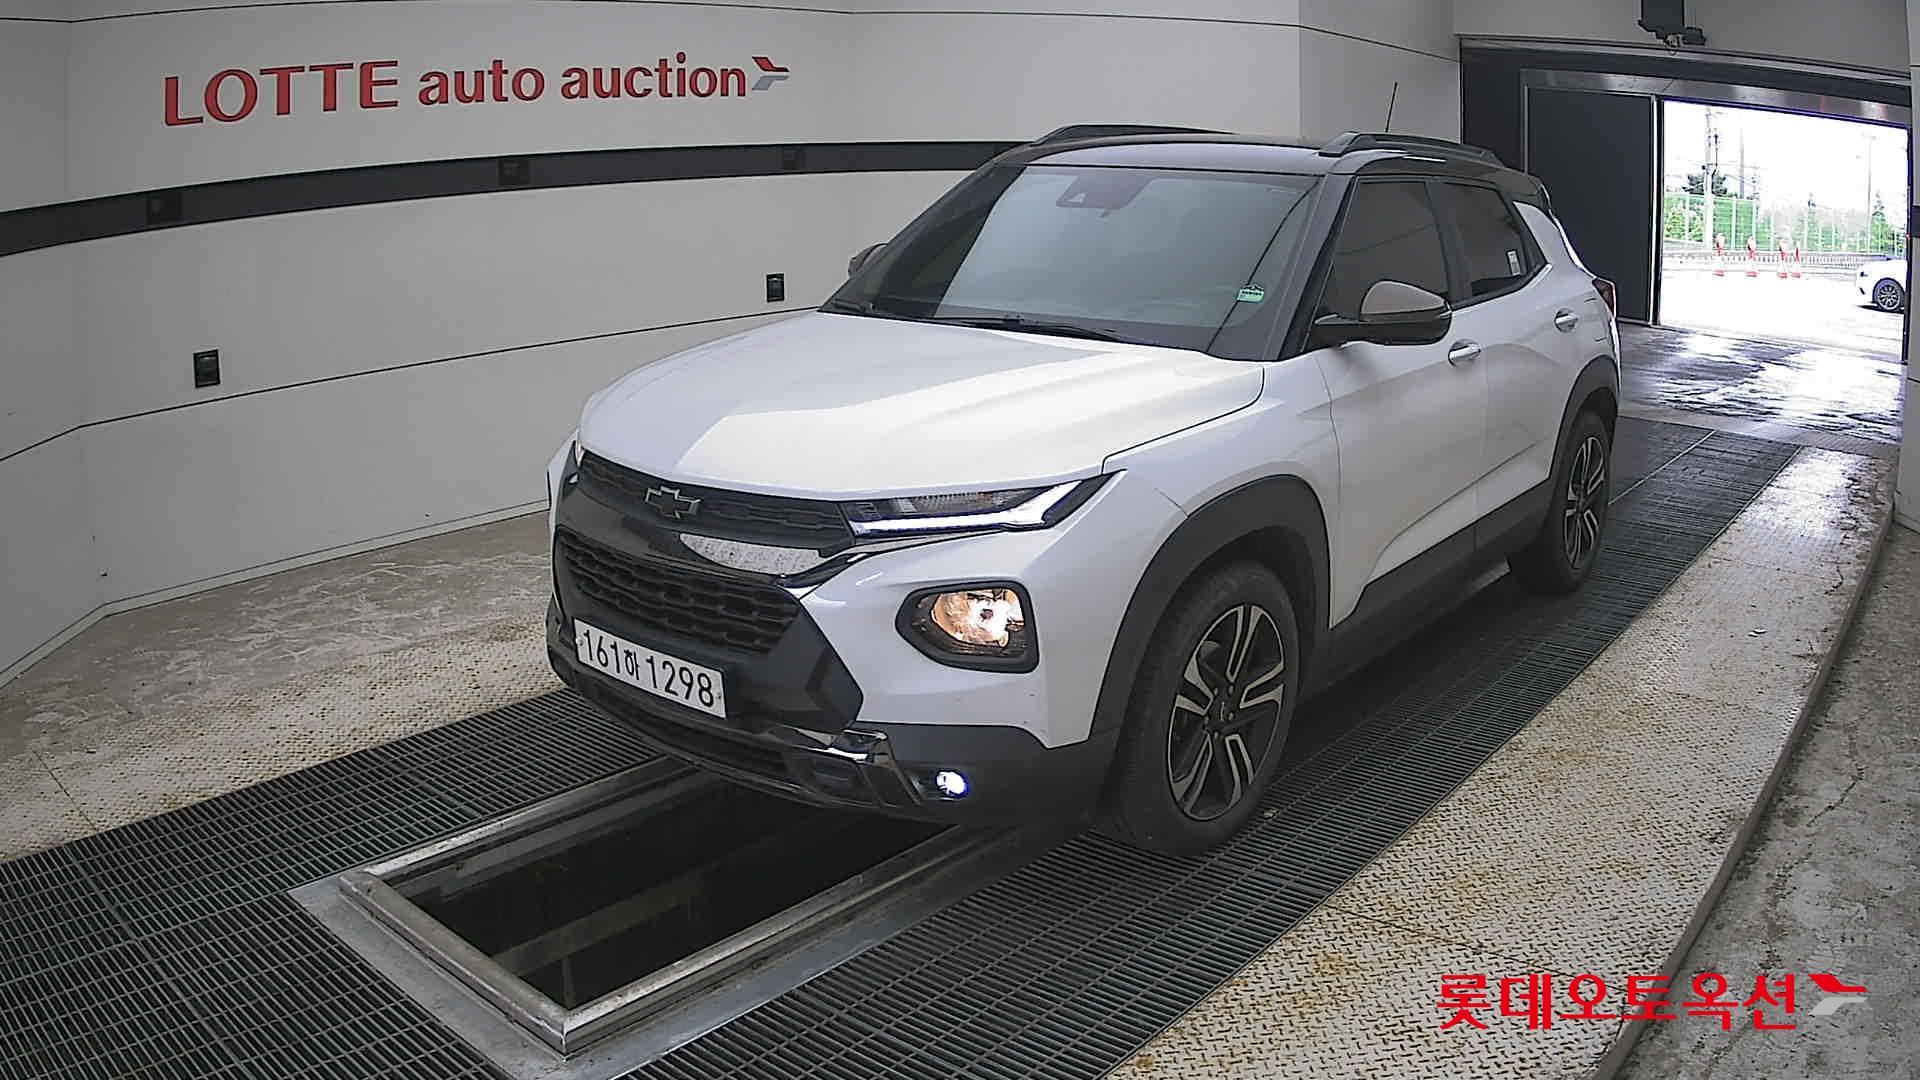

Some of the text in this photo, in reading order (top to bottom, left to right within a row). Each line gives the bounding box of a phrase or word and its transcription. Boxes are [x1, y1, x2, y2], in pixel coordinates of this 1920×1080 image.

[165, 52, 745, 125] LOTTE auto auction
